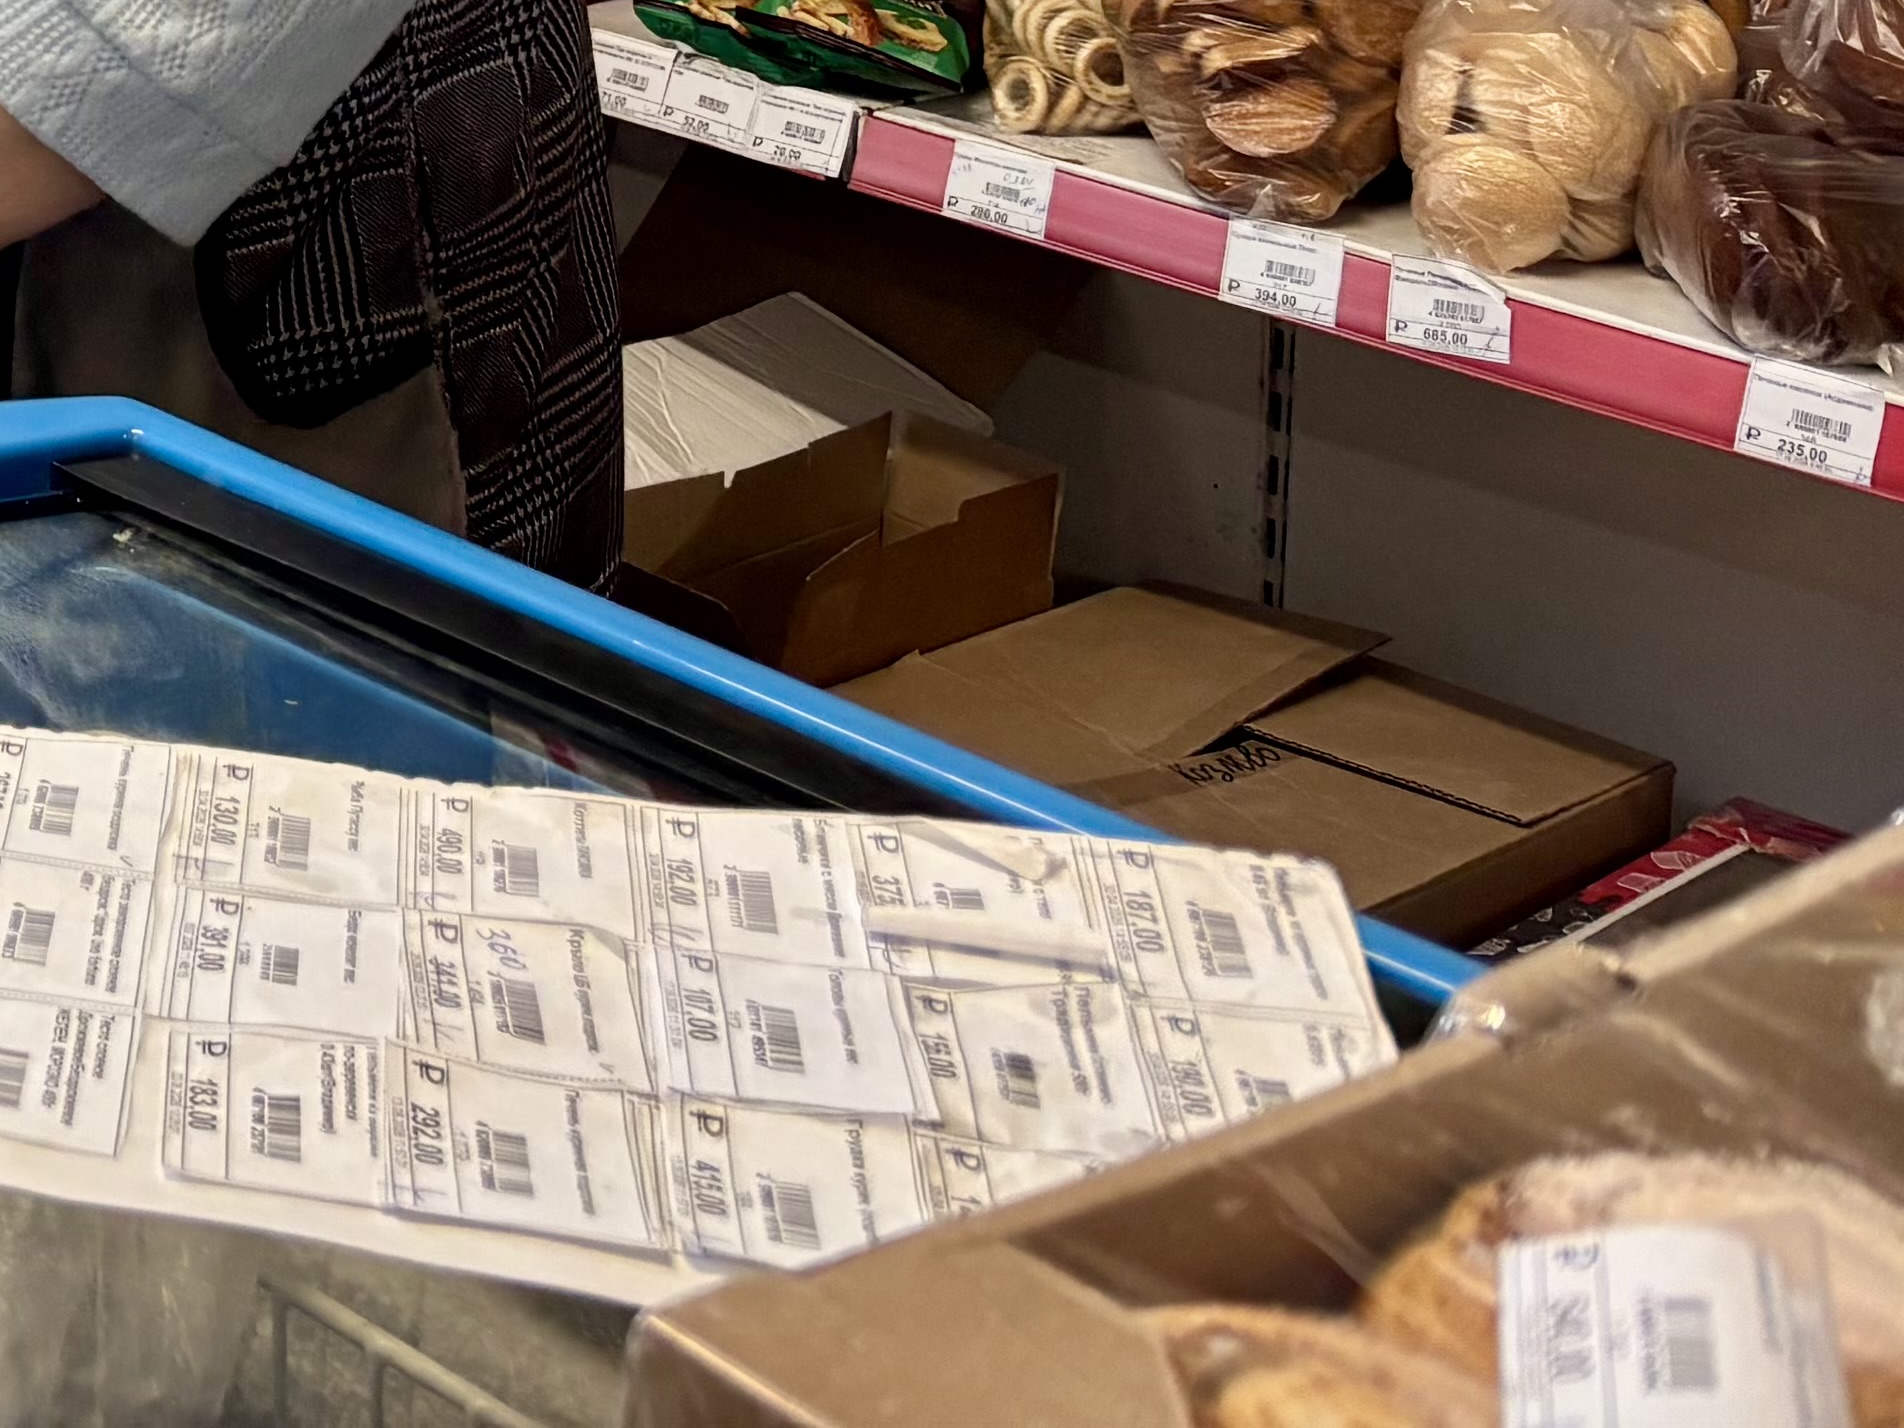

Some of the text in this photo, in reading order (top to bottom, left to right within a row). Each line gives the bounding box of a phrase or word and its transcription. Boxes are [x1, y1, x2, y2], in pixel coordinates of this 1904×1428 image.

[1776, 436, 1829, 464] 235,00
[210, 795, 240, 845] 130,00
[434, 827, 464, 874] 490,00
[656, 858, 687, 906] 192,00
[1122, 886, 1167, 955] 187,00
[196, 925, 228, 972] 391,00
[682, 987, 717, 1042] 107,00
[186, 1077, 219, 1131] 183,00
[410, 1102, 444, 1165] 292,00
[690, 1158, 728, 1221] 415,00
